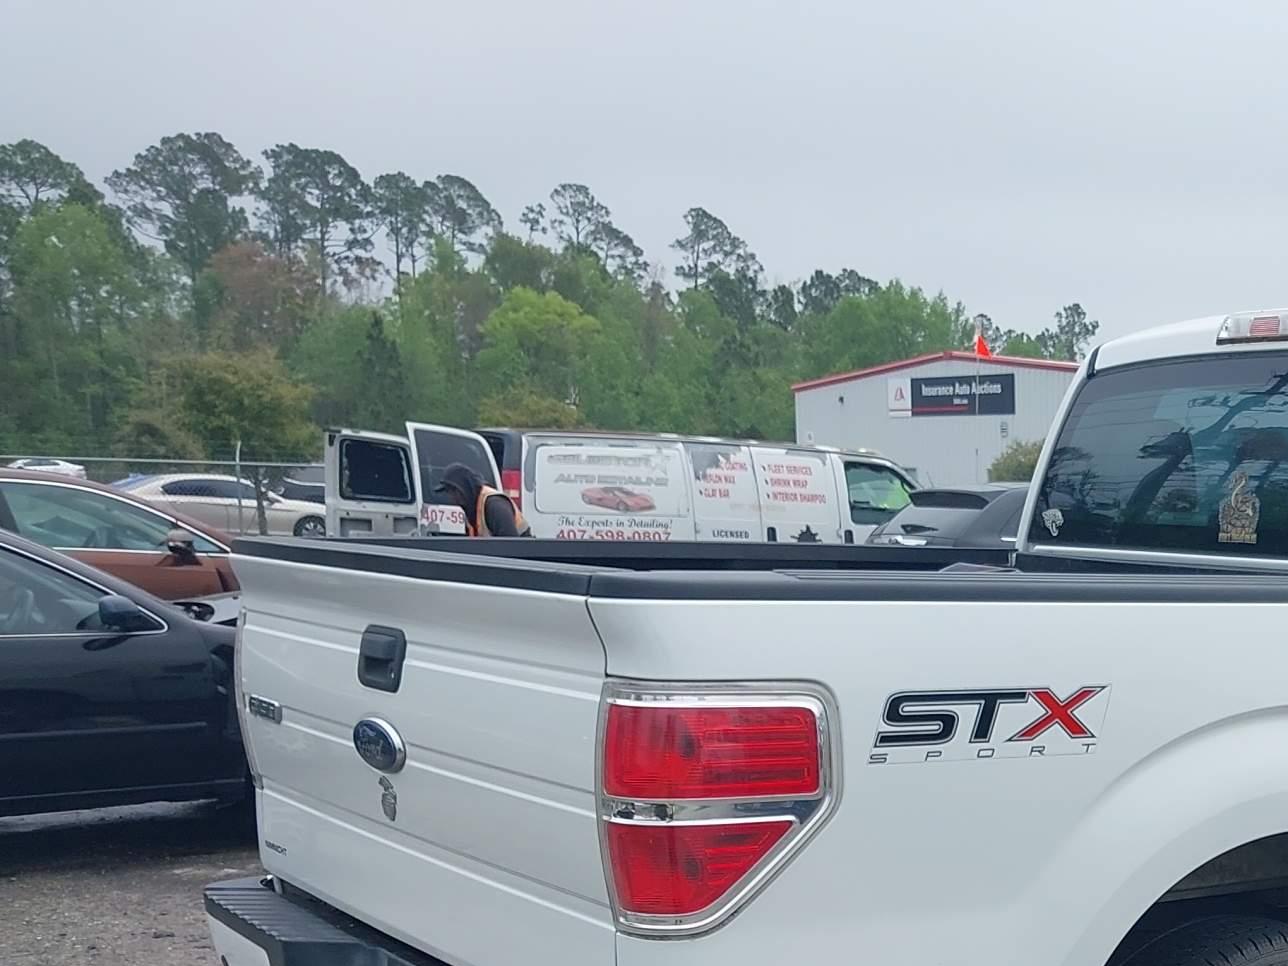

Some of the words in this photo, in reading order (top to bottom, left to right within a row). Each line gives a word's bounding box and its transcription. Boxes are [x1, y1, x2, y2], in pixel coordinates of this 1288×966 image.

[922, 383, 953, 396] Insurance
[955, 381, 970, 396] Auto
[971, 381, 1002, 395] Auctions
[768, 464, 784, 475] FLEET
[786, 465, 813, 476] SERVICES
[792, 480, 808, 489] WRAP
[558, 516, 575, 528] The
[578, 516, 614, 529] Experts
[616, 519, 625, 528] in
[712, 529, 750, 539] LICENSED
[874, 686, 1107, 748] STX
[868, 743, 1097, 764] SPORT
